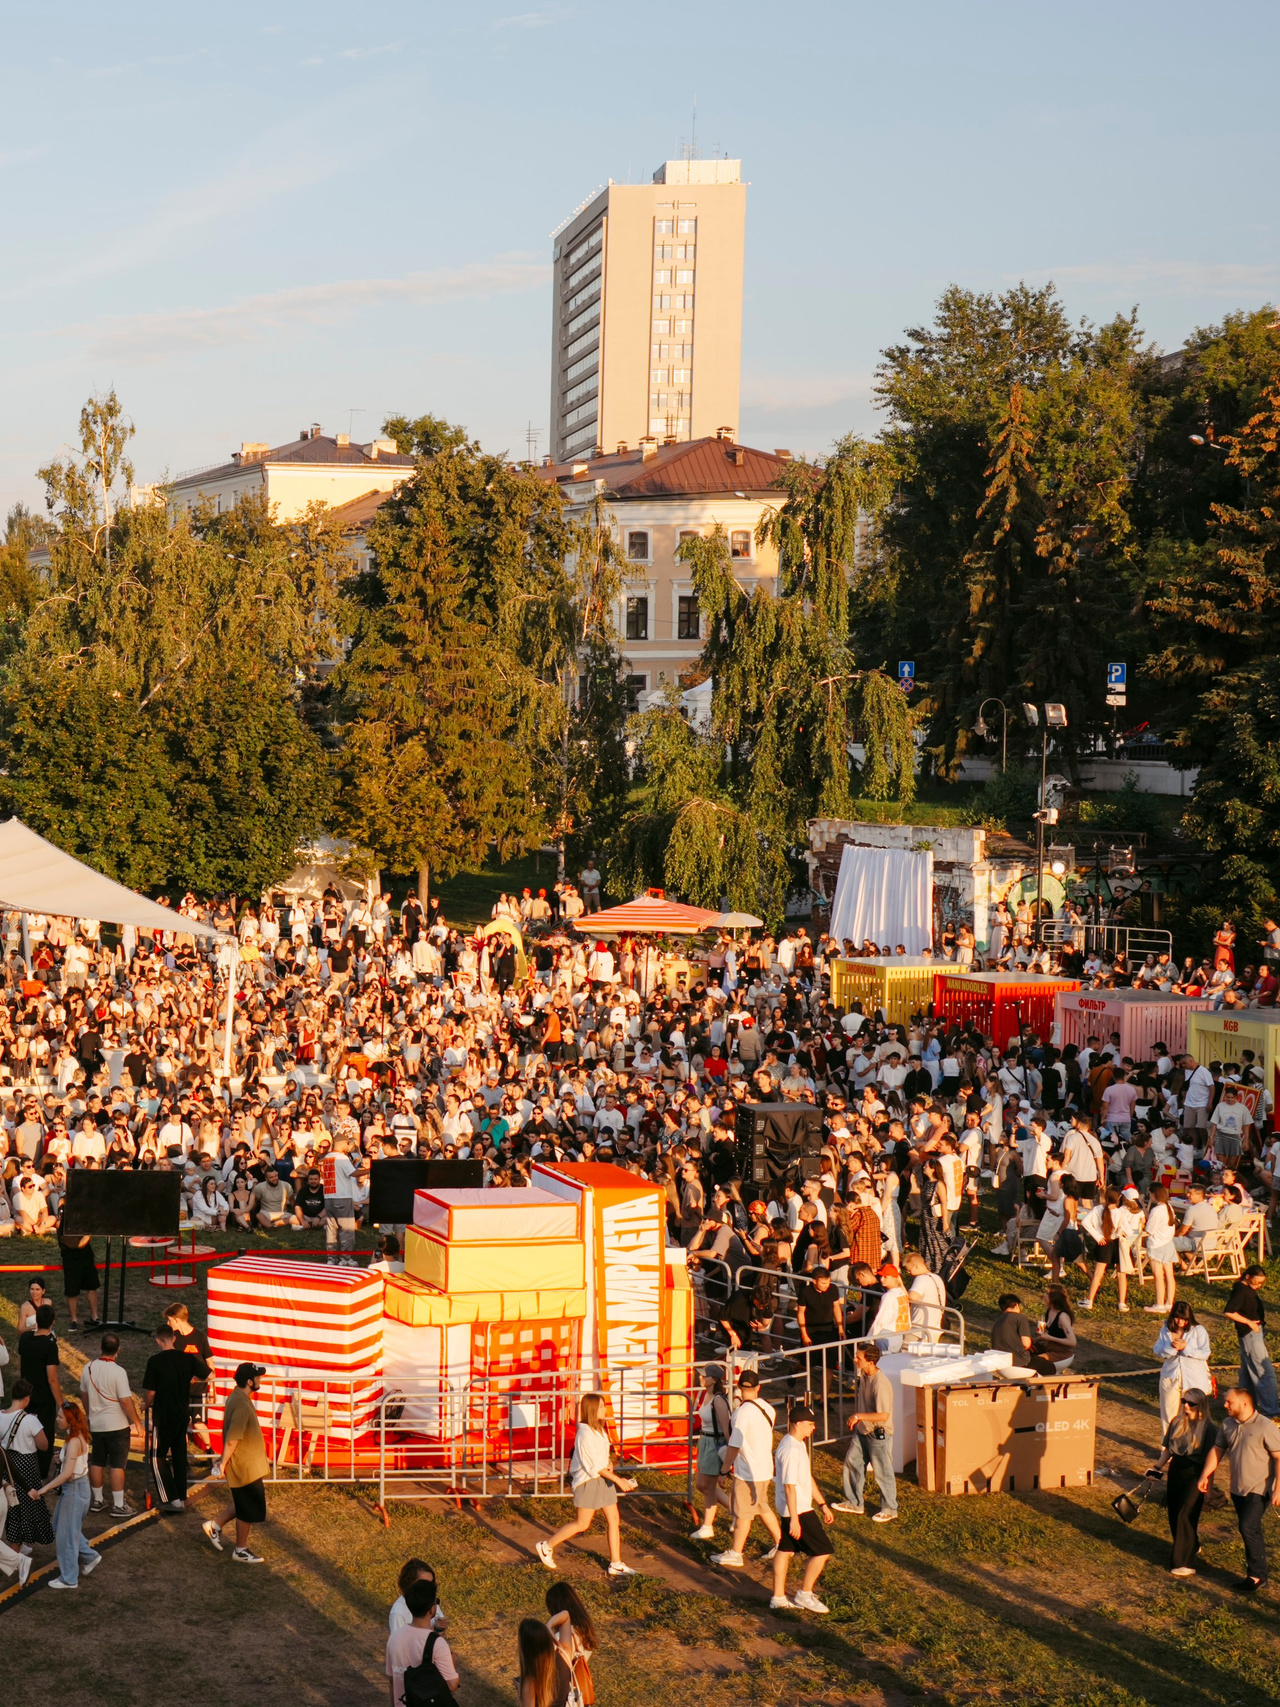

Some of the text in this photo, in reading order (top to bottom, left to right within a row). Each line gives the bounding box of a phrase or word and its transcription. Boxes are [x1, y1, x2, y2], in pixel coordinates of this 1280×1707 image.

[1111, 665, 1122, 681] P
[845, 963, 877, 977] SMORODINA
[946, 978, 988, 994] NANI NOODLES
[1078, 998, 1106, 1012] ФИЛЬТР
[1223, 1019, 1239, 1033] KGB
[602, 1193, 660, 1322] МАРКЕТА
[1035, 1418, 1091, 1433] QLED 4K
